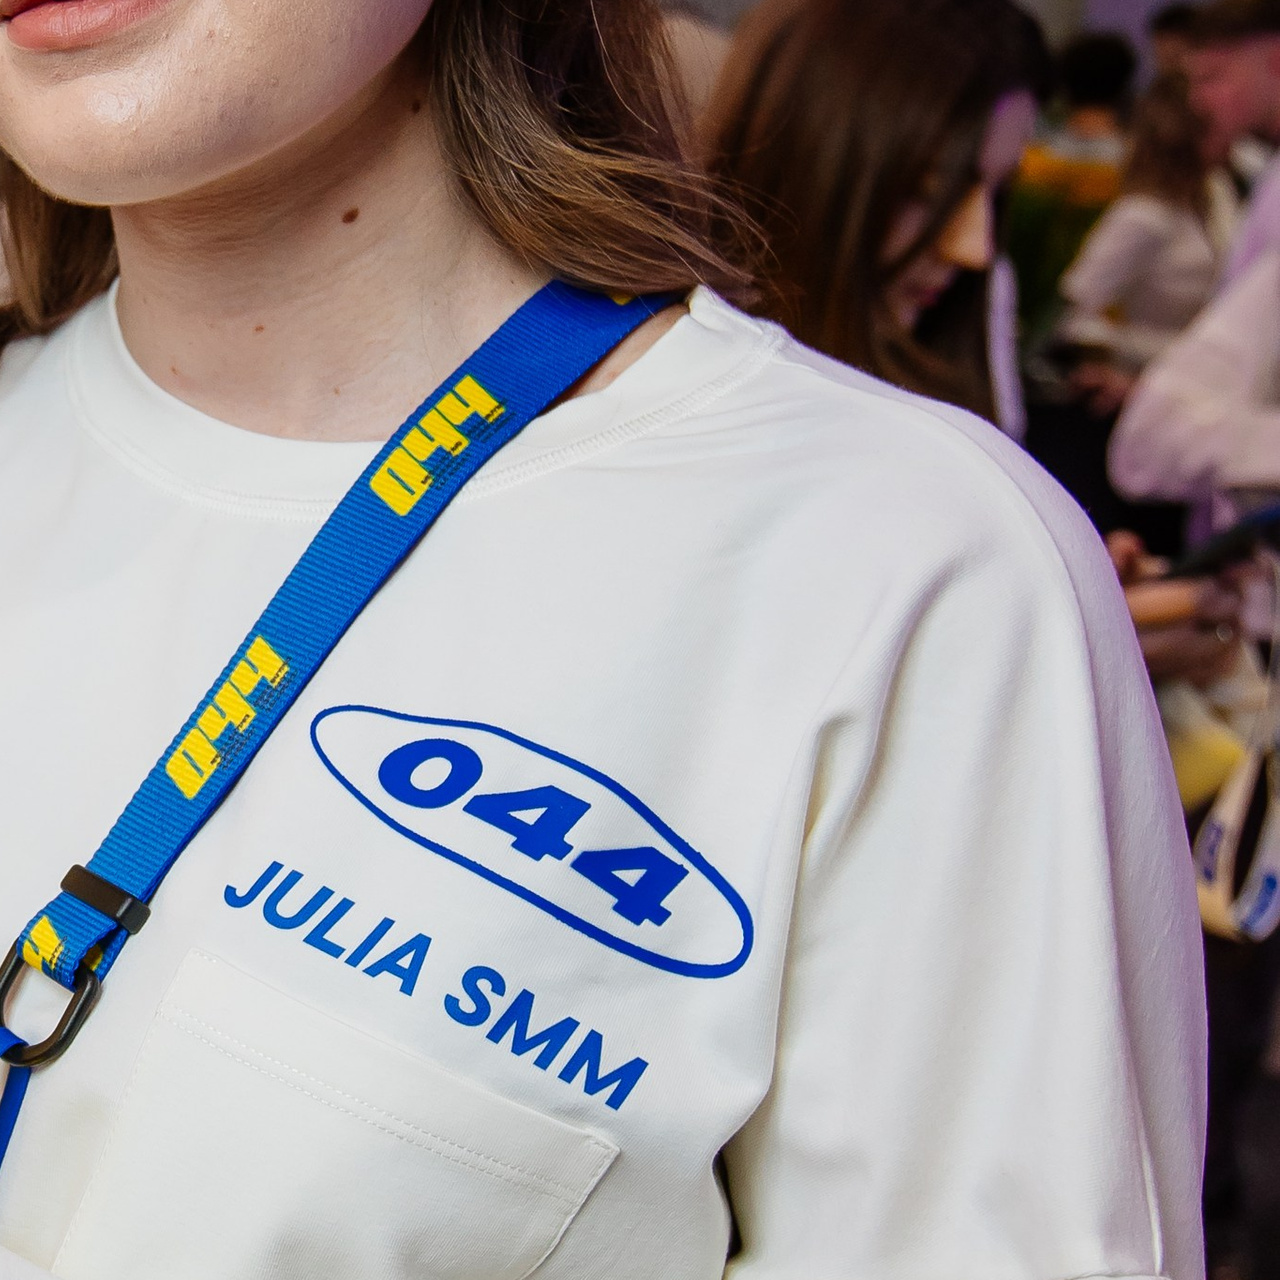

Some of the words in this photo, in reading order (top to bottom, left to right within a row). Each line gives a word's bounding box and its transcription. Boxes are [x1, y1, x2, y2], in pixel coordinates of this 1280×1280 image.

[378, 739, 688, 925] 044
[224, 861, 431, 996] JULIA
[444, 965, 648, 1110] SMM
